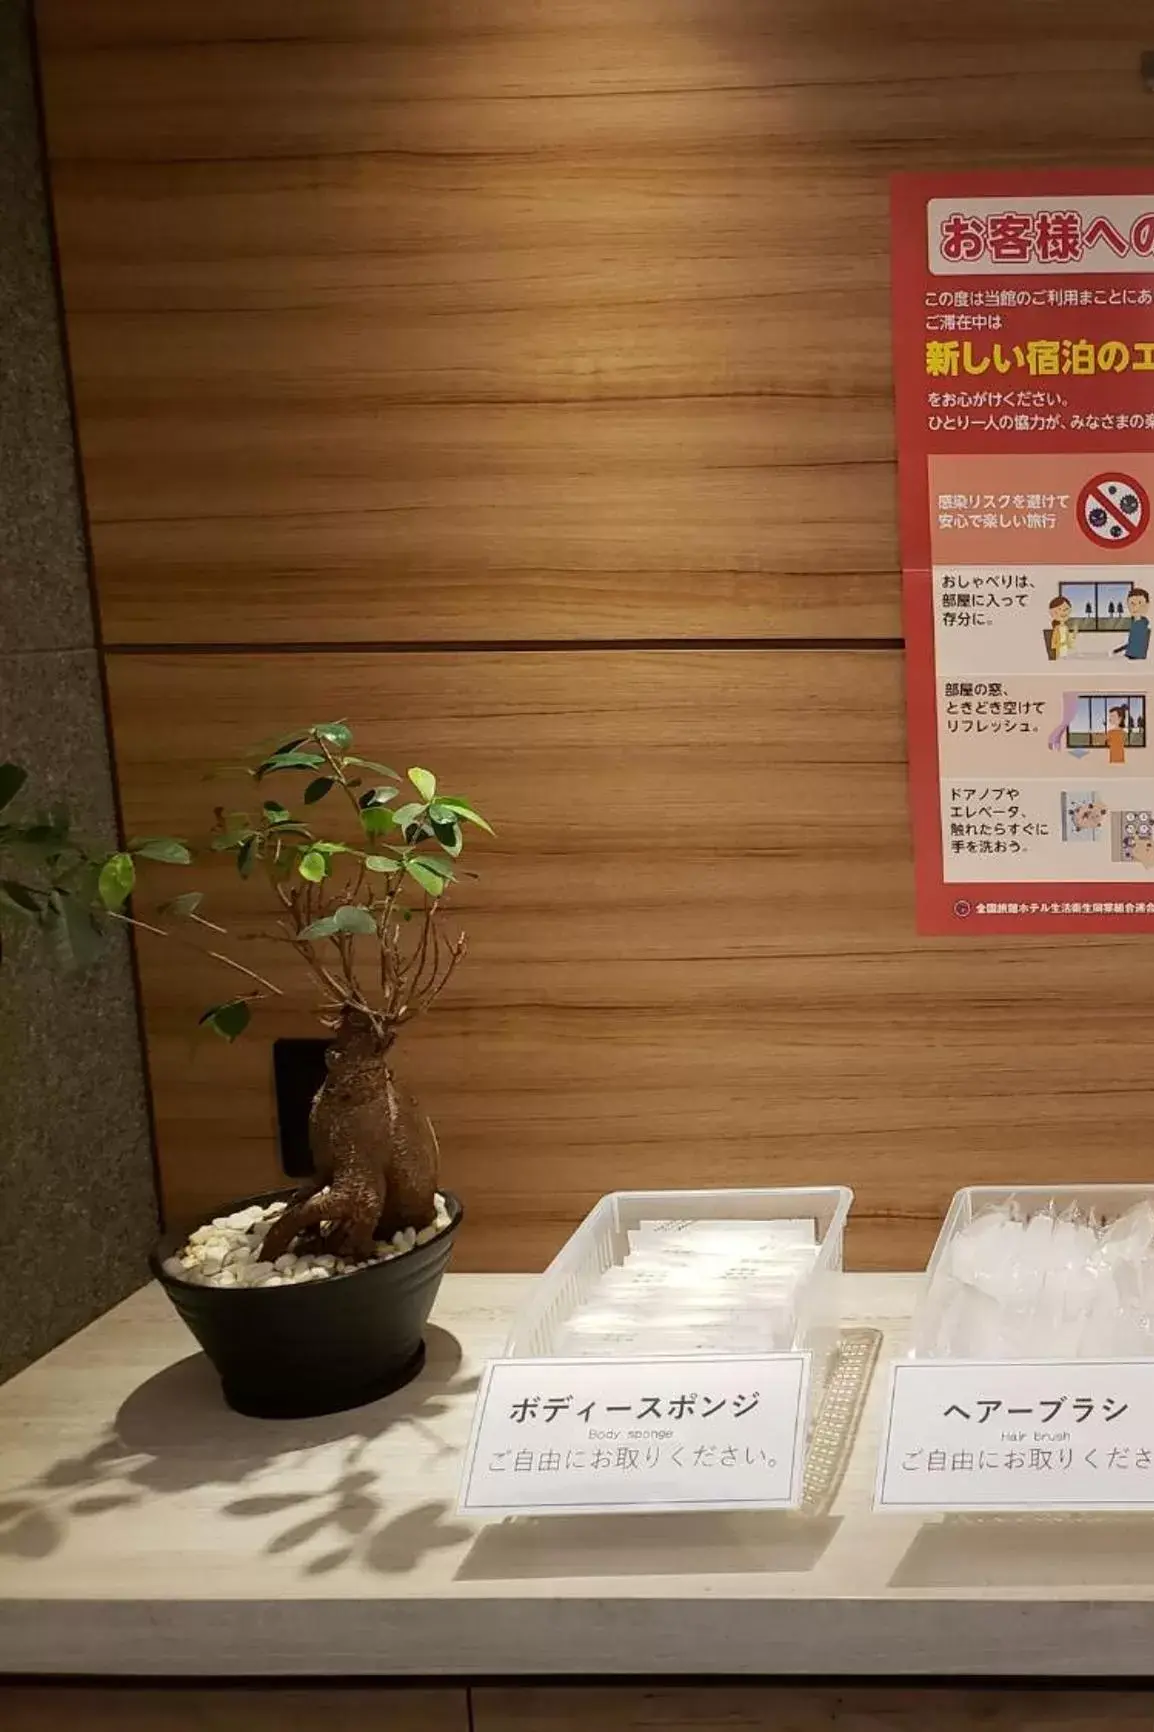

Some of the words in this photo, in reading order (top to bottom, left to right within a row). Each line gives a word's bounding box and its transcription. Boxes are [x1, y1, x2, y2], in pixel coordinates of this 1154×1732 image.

[925, 314, 1003, 331] ご滞在中は
[927, 391, 1069, 408] をお心がけください。
[937, 494, 1071, 511] 感染リスクを避けて
[937, 513, 1058, 530] 安心で楽しい旅行
[941, 574, 1036, 589] おしゃべりは、
[941, 593, 1030, 608] 部屋に入って
[942, 611, 994, 627] 存分に。
[944, 682, 1009, 698] 部屋の窓、
[946, 701, 1046, 716] ときどき空けて
[947, 719, 1040, 734] リフレッシュ。
[951, 787, 1020, 801] ドアノブや
[950, 805, 1027, 819] エレベータ、
[951, 822, 1050, 837] 触れたらすぐに
[951, 839, 1028, 854] 手を洗おう。
[509, 1391, 761, 1423] ボディースポンジ
[943, 1395, 1130, 1423] ヘアーブラシ
[588, 1428, 621, 1441] Body
[627, 1427, 675, 1442] sponge
[1001, 1431, 1028, 1442] Hair
[1033, 1430, 1072, 1442] brush
[487, 1443, 779, 1473] ご自由にお取りください。
